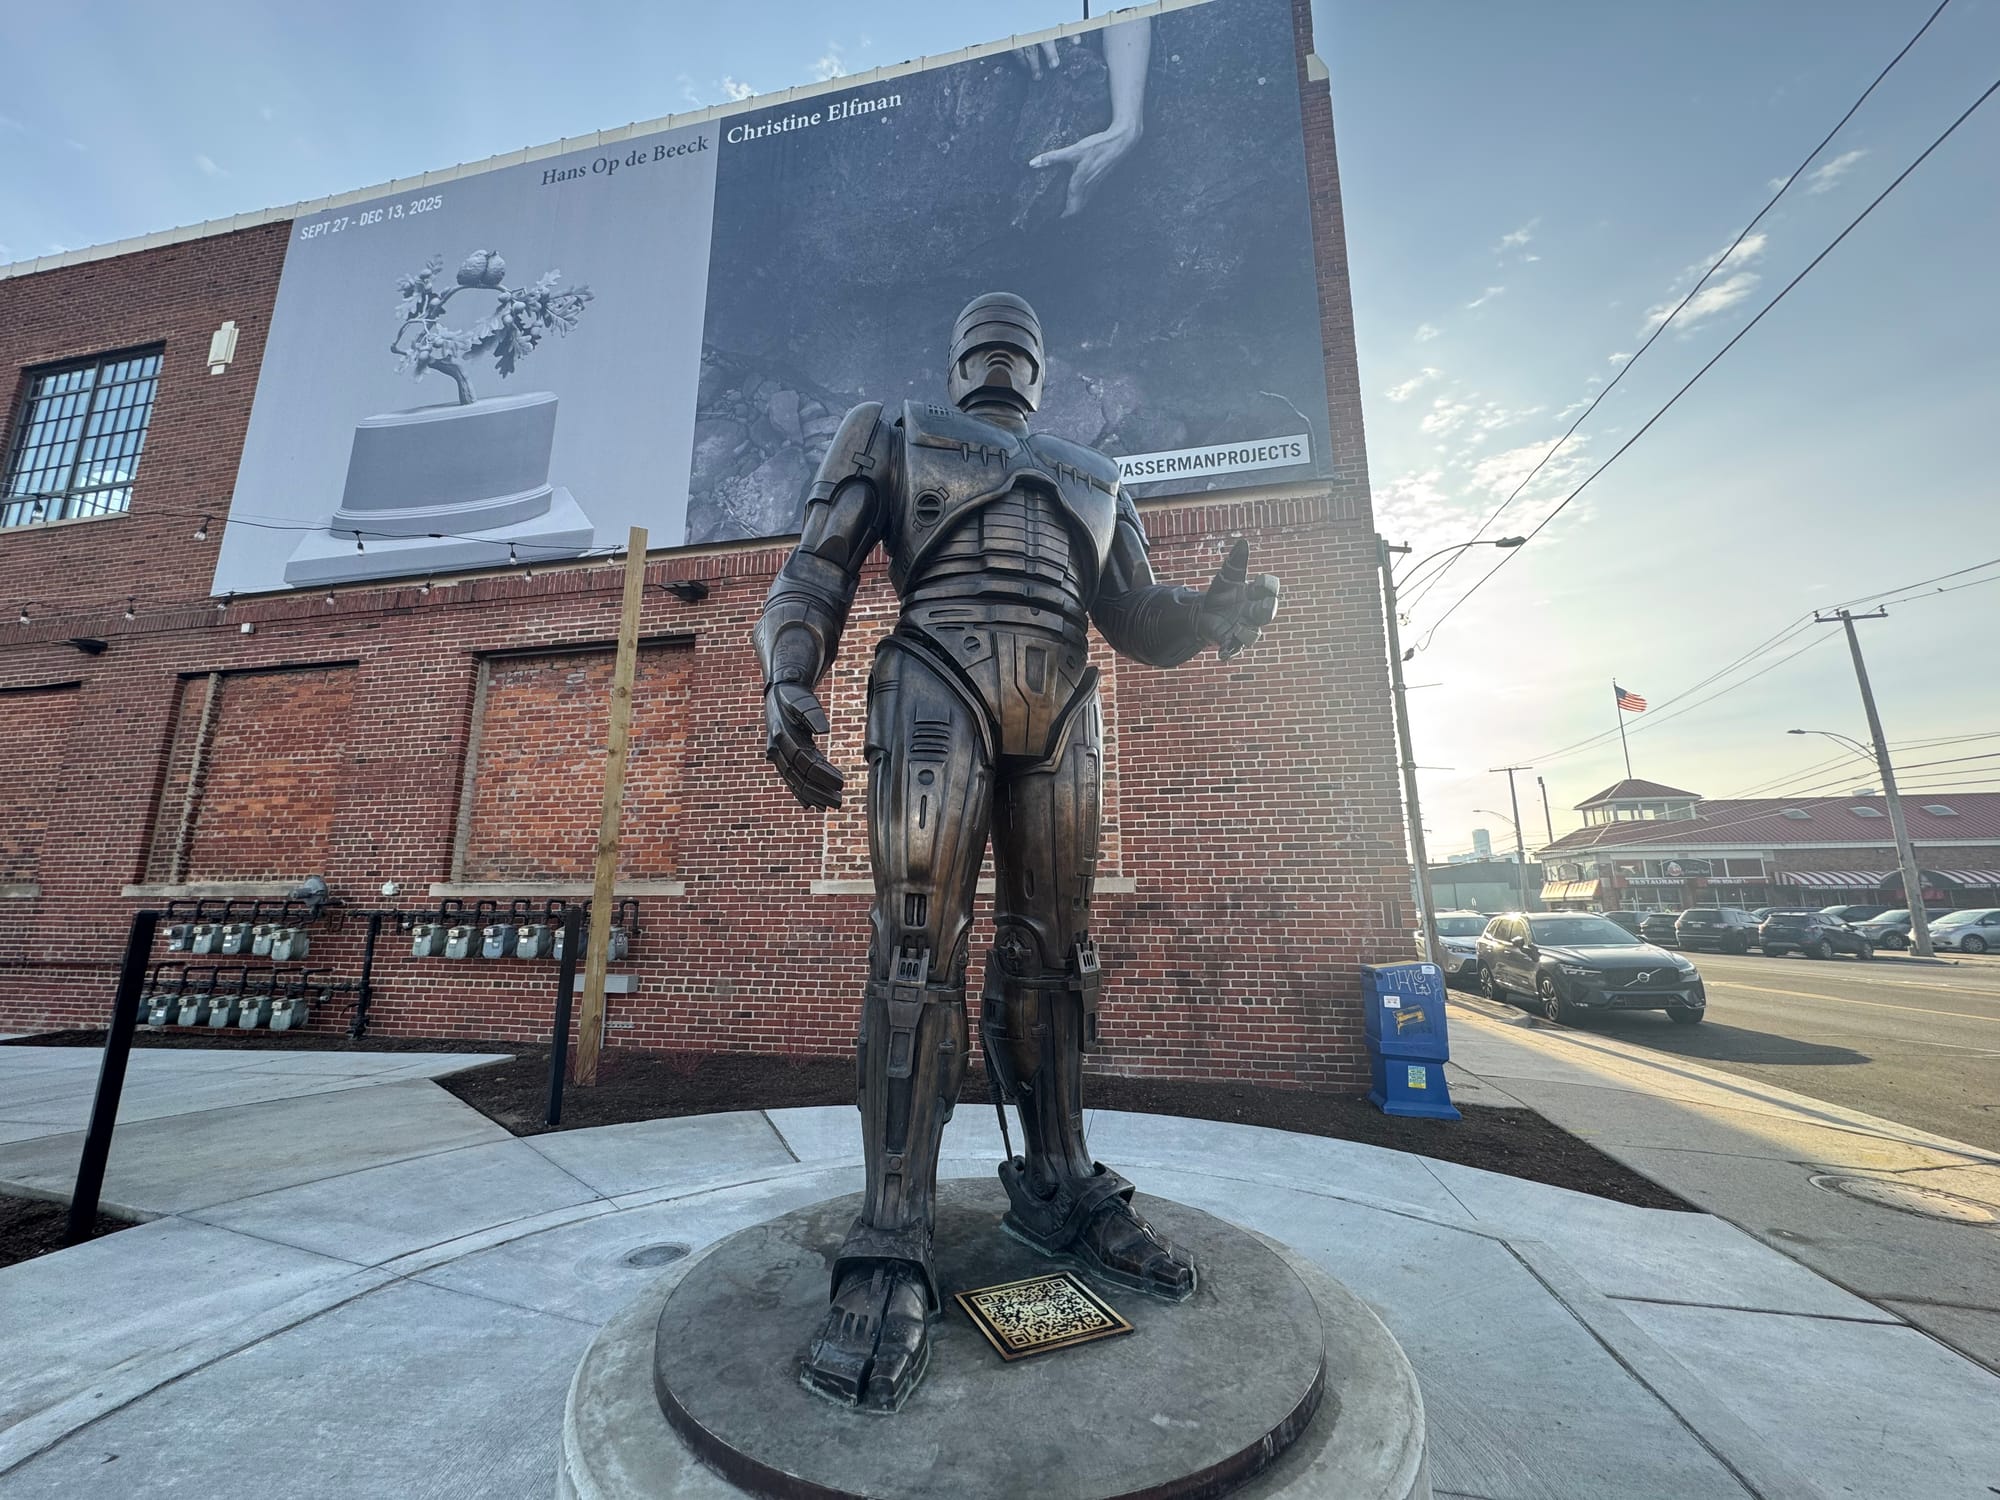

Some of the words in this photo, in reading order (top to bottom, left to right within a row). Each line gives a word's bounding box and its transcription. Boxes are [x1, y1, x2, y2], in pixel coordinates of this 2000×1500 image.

[727, 112, 821, 144] Christine
[827, 94, 902, 122] Elfman
[541, 165, 587, 186] Hans
[592, 158, 620, 176] Op
[625, 150, 647, 167] de
[652, 135, 709, 162] Beeck
[300, 221, 331, 240] SEPT
[331, 216, 349, 233] 27
[360, 209, 383, 227] DEC
[388, 204, 405, 219] 13,
[409, 195, 443, 215] 2025
